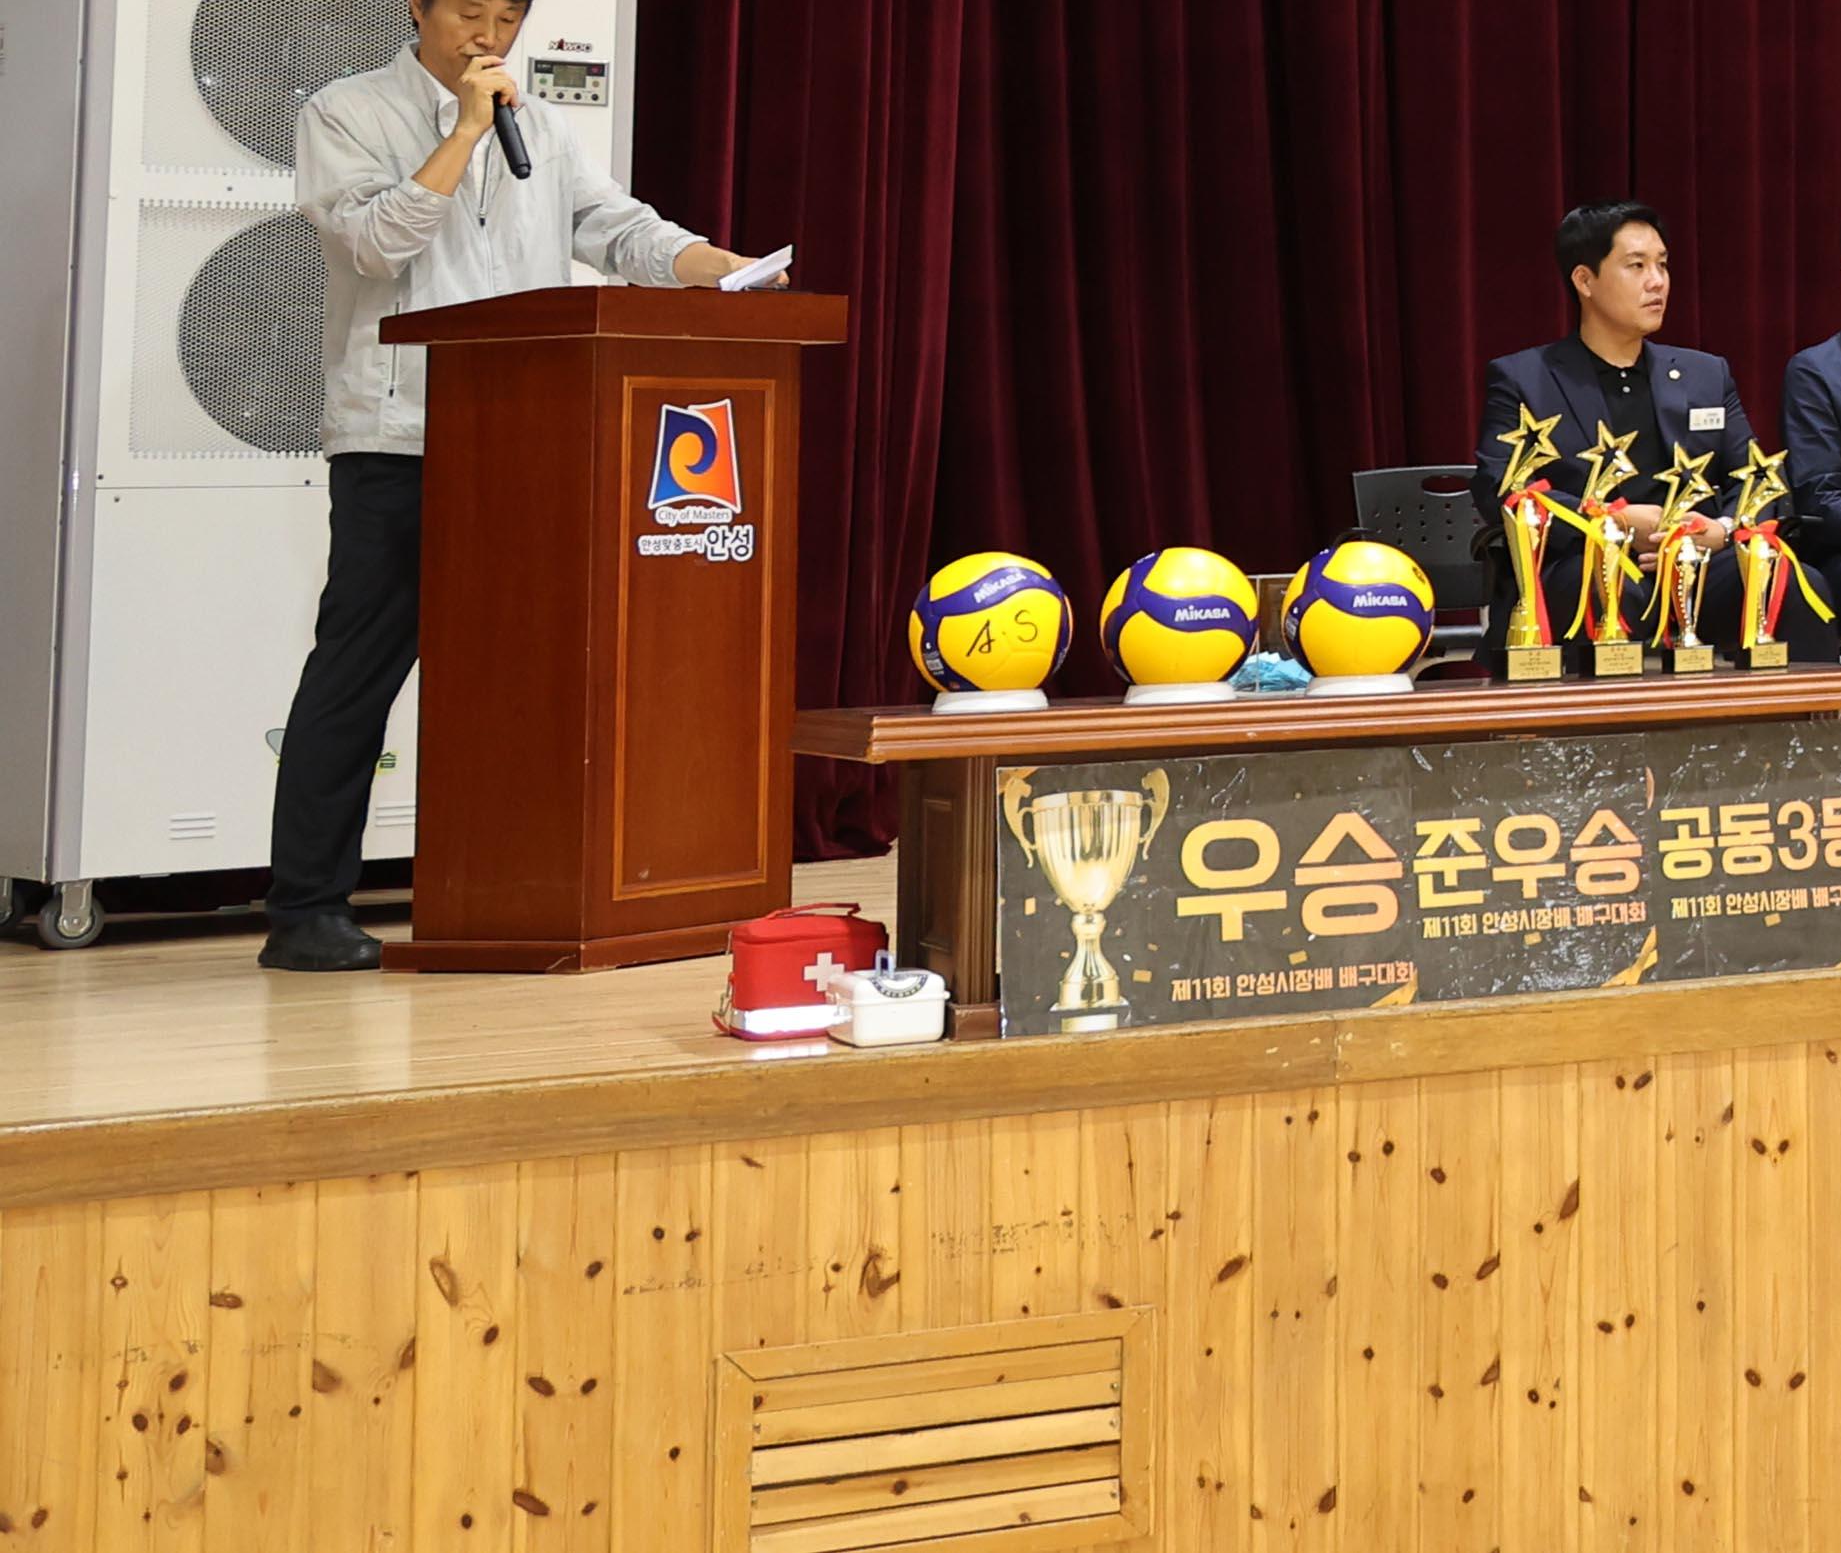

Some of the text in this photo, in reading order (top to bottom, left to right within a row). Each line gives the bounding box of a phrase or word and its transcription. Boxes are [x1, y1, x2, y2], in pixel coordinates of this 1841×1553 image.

[658, 509, 731, 522] City of Masters
[641, 528, 751, 557] 안성맞춤도시 안성
[1176, 812, 1403, 942] 우승
[1412, 809, 1643, 909] 준우승
[1422, 901, 1647, 939] 제11회 안성시장배 배구대회
[1671, 895, 1722, 920] 제11회
[1726, 888, 1809, 915] 안성시장배
[1170, 961, 1416, 1002] 제11회 안성시장배 배구대회
